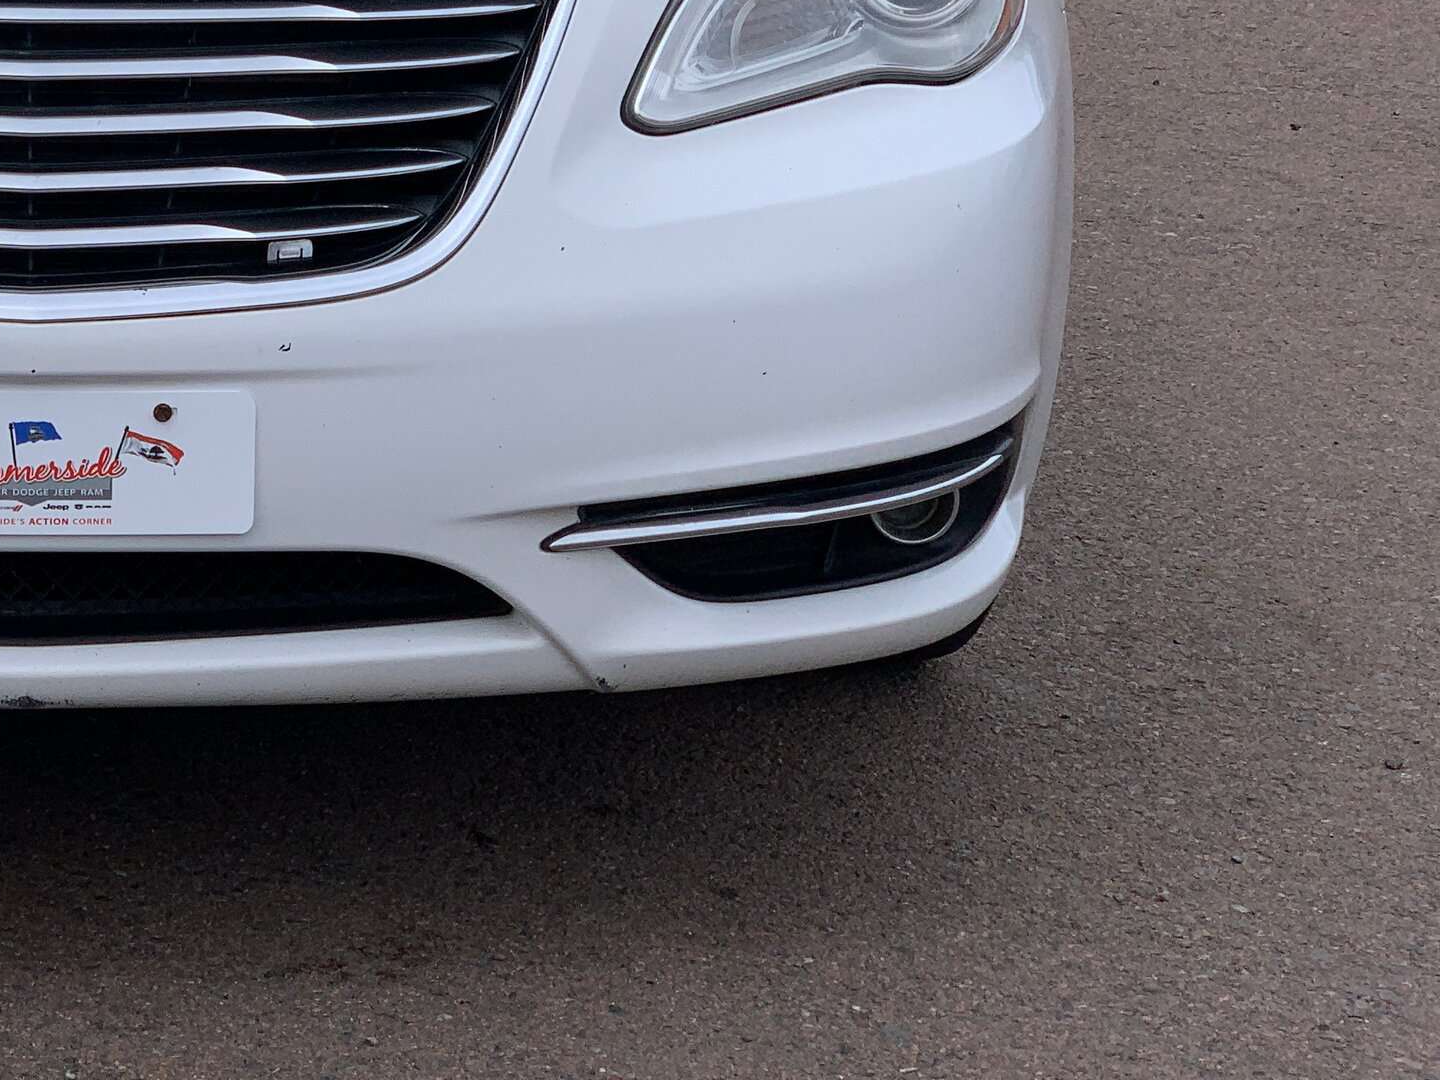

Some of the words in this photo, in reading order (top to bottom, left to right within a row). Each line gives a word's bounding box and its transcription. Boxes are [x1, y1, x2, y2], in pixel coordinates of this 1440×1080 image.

[13, 488, 49, 496] DODGE
[54, 488, 76, 496] JEEP
[81, 488, 104, 497] RAM
[43, 503, 69, 511] Jeep
[28, 517, 69, 526] ACTION
[72, 517, 112, 526] CORNER
